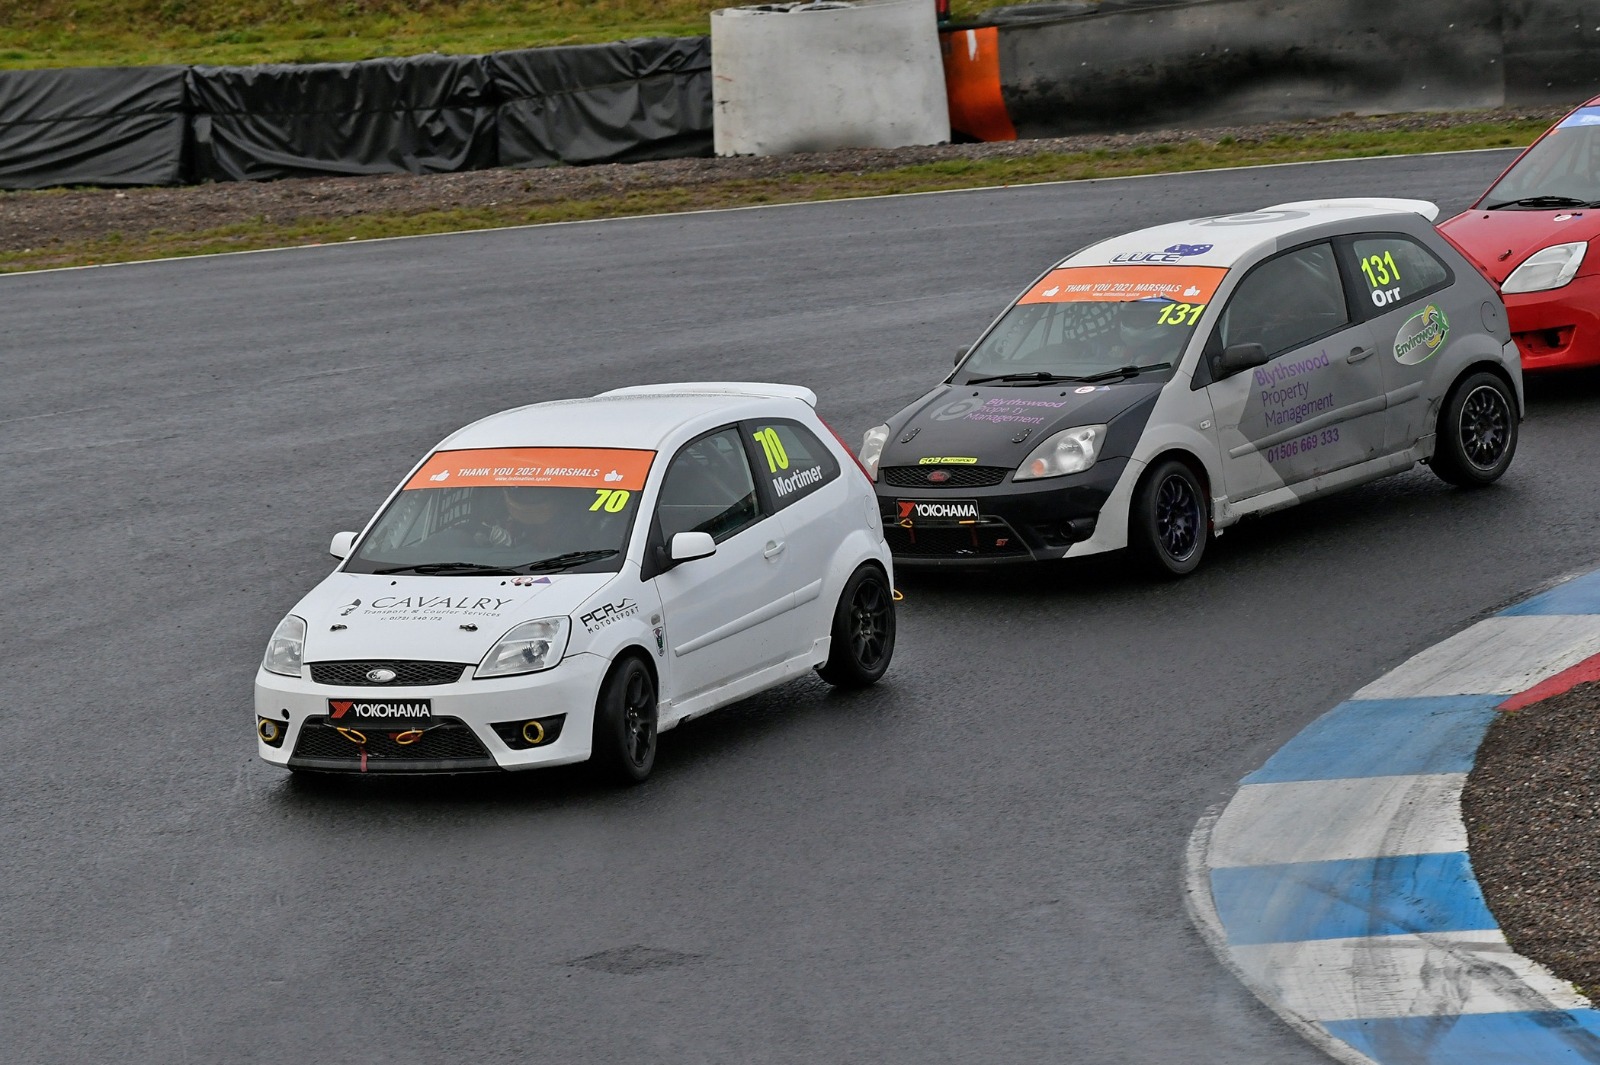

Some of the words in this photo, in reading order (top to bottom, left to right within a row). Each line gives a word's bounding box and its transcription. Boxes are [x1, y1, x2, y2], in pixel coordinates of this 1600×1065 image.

[1111, 252, 1181, 263] LUCE
[1361, 250, 1401, 288] 131
[1064, 284, 1092, 293] THANK
[1092, 283, 1111, 292] YOU
[1113, 283, 1133, 292] 2021
[1134, 283, 1183, 293] MARSHALS
[1371, 286, 1401, 307] Orr
[1156, 303, 1206, 326] 131
[1254, 349, 1330, 389] Blythswood
[986, 398, 1067, 408] Blythswood
[1261, 381, 1309, 407] Property
[964, 413, 1044, 424] Management
[1264, 392, 1334, 428] Management
[753, 427, 789, 473] 70
[1267, 441, 1299, 463] 01506
[1300, 434, 1318, 452] 669
[1320, 428, 1340, 446] 333
[457, 467, 491, 477] THANK
[492, 467, 515, 476] YOU
[516, 467, 541, 476] 2021
[543, 467, 600, 478] MARSHALS
[772, 465, 823, 498] Mortimer
[588, 489, 630, 513] 70
[915, 504, 978, 517] YOKOHAMA
[371, 596, 513, 610] CAVALRY
[587, 606, 640, 634] MOTORSPORT
[352, 703, 431, 718] YOKOHAMA
